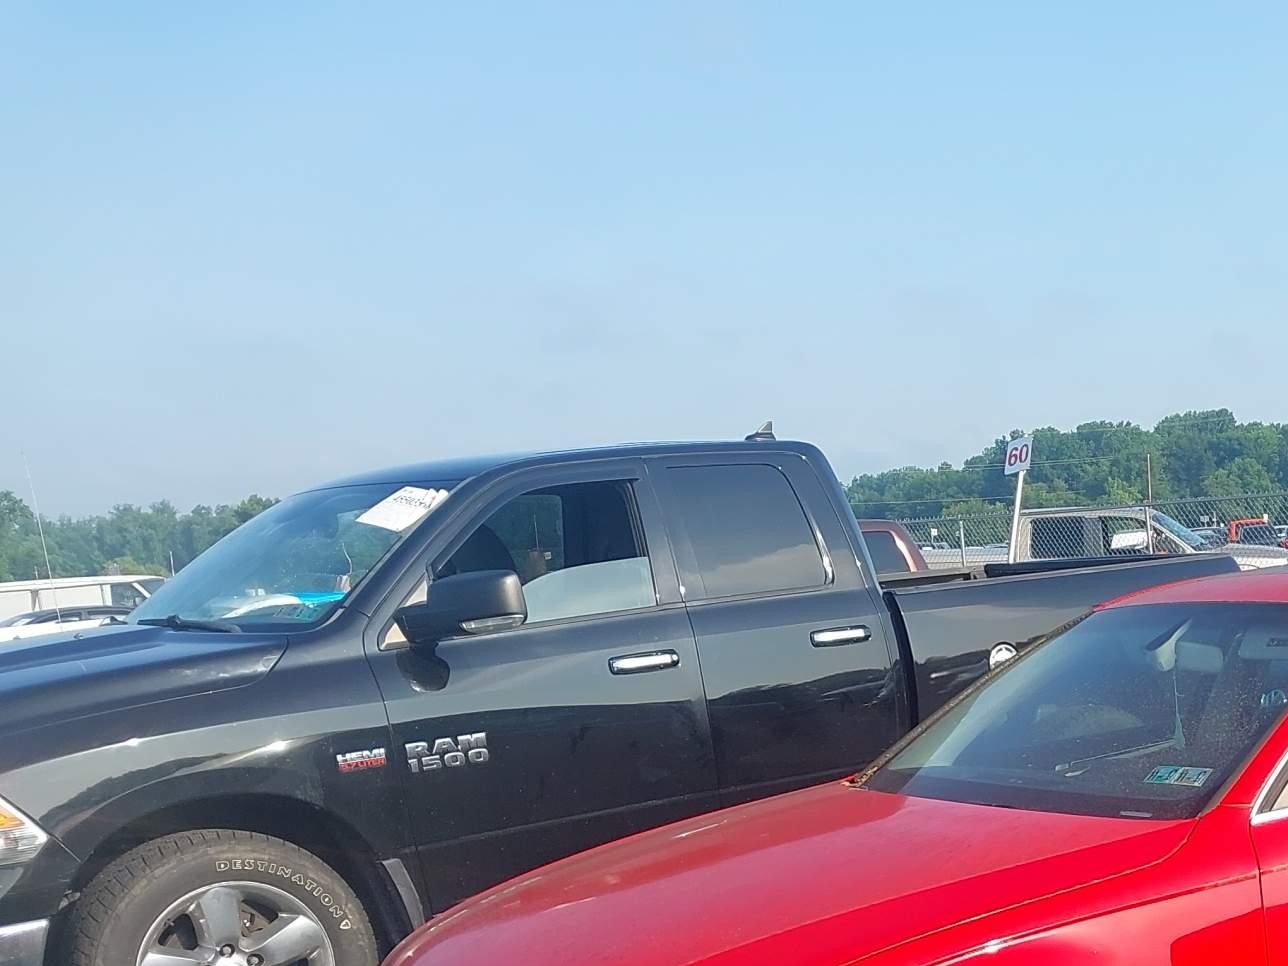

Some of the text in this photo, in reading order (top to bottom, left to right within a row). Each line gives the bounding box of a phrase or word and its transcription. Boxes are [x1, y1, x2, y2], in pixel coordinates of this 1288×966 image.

[1008, 444, 1028, 466] 60
[336, 748, 386, 763] HEMI
[404, 732, 487, 759] RAM
[407, 748, 489, 773] 1500
[215, 859, 344, 918] DESTINATION
